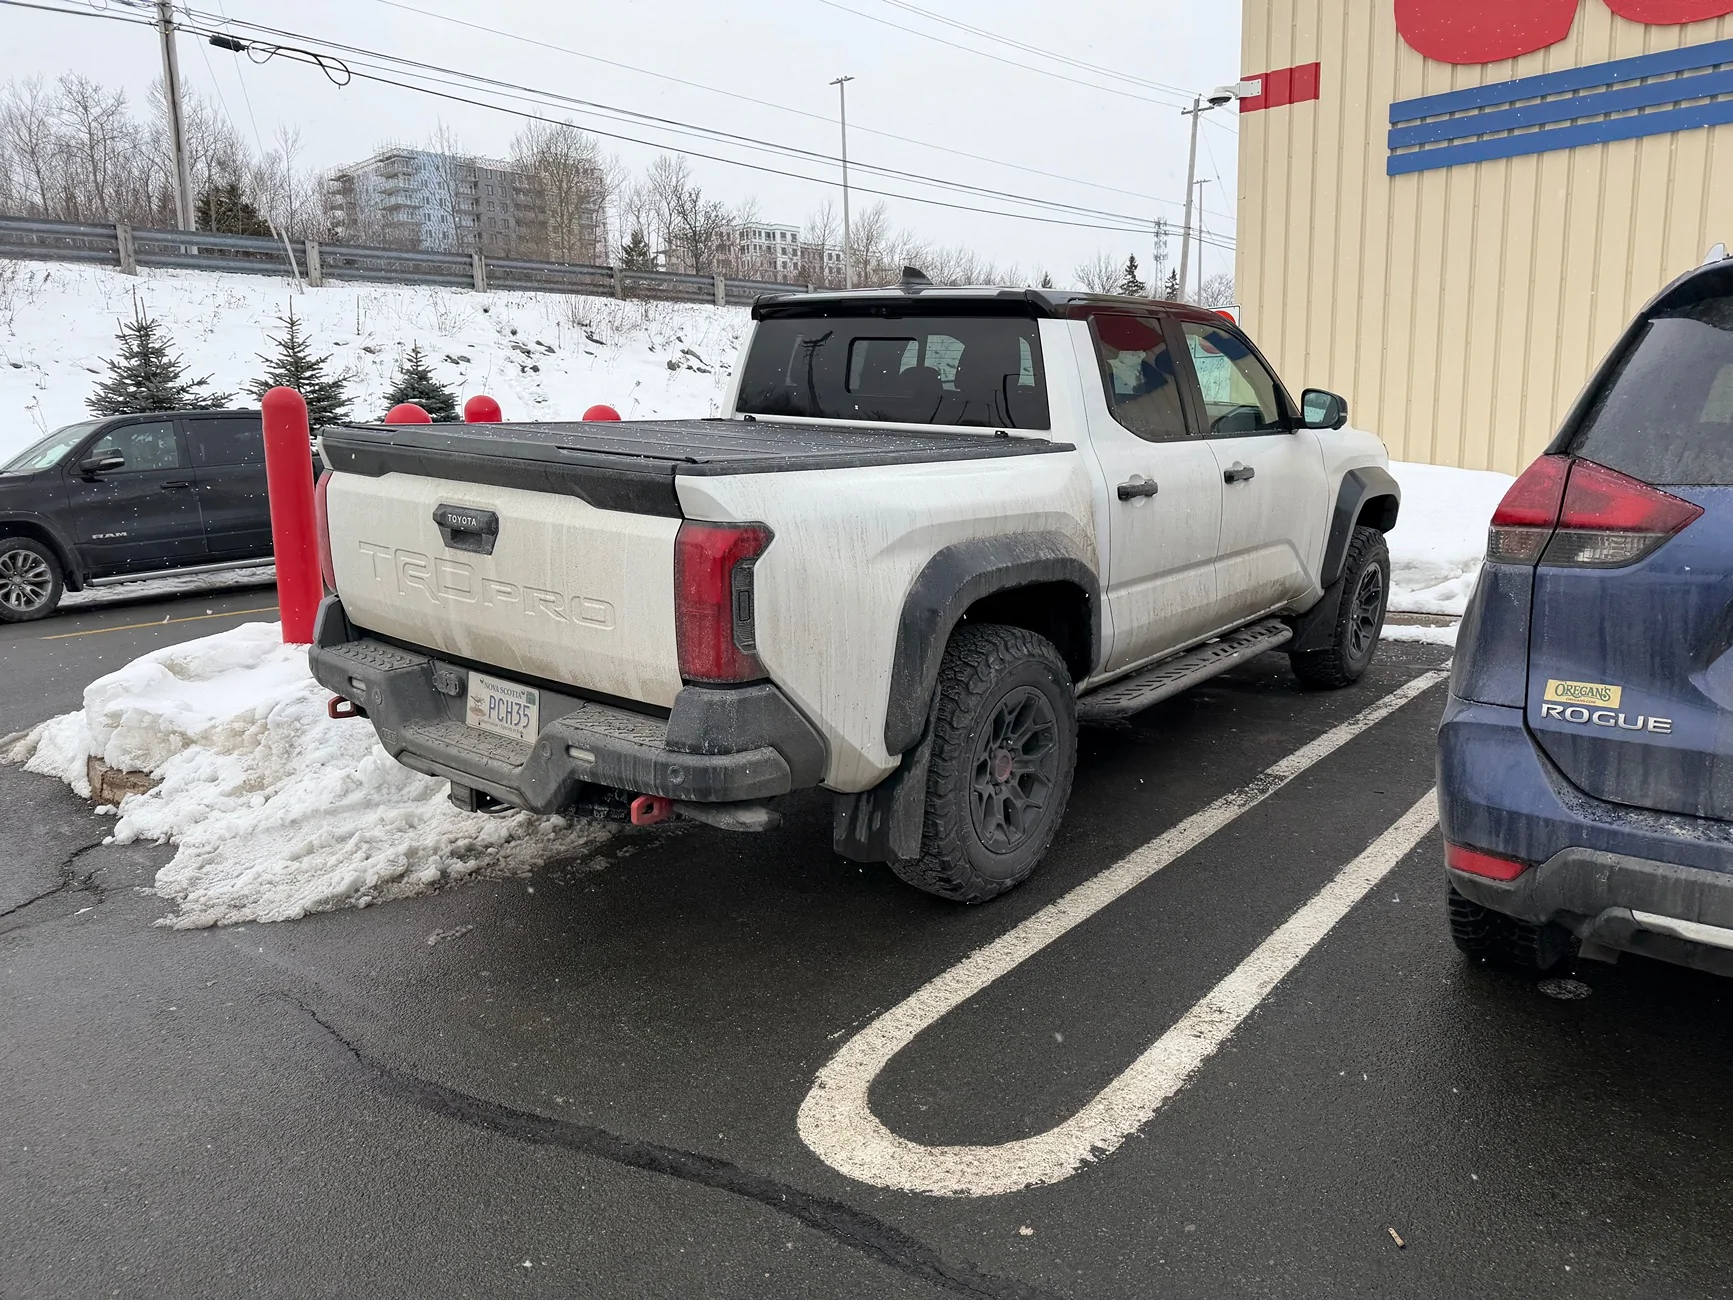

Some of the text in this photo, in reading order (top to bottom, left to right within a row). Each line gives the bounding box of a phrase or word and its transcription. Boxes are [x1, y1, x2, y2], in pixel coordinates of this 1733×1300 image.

[447, 514, 477, 526] TOYOTA
[92, 531, 127, 539] RAM
[358, 540, 616, 631] TRD PRO
[484, 682, 522, 700] NOVA SCOTIA
[488, 694, 531, 729] PCH35
[1541, 703, 1673, 734] ROGUE
